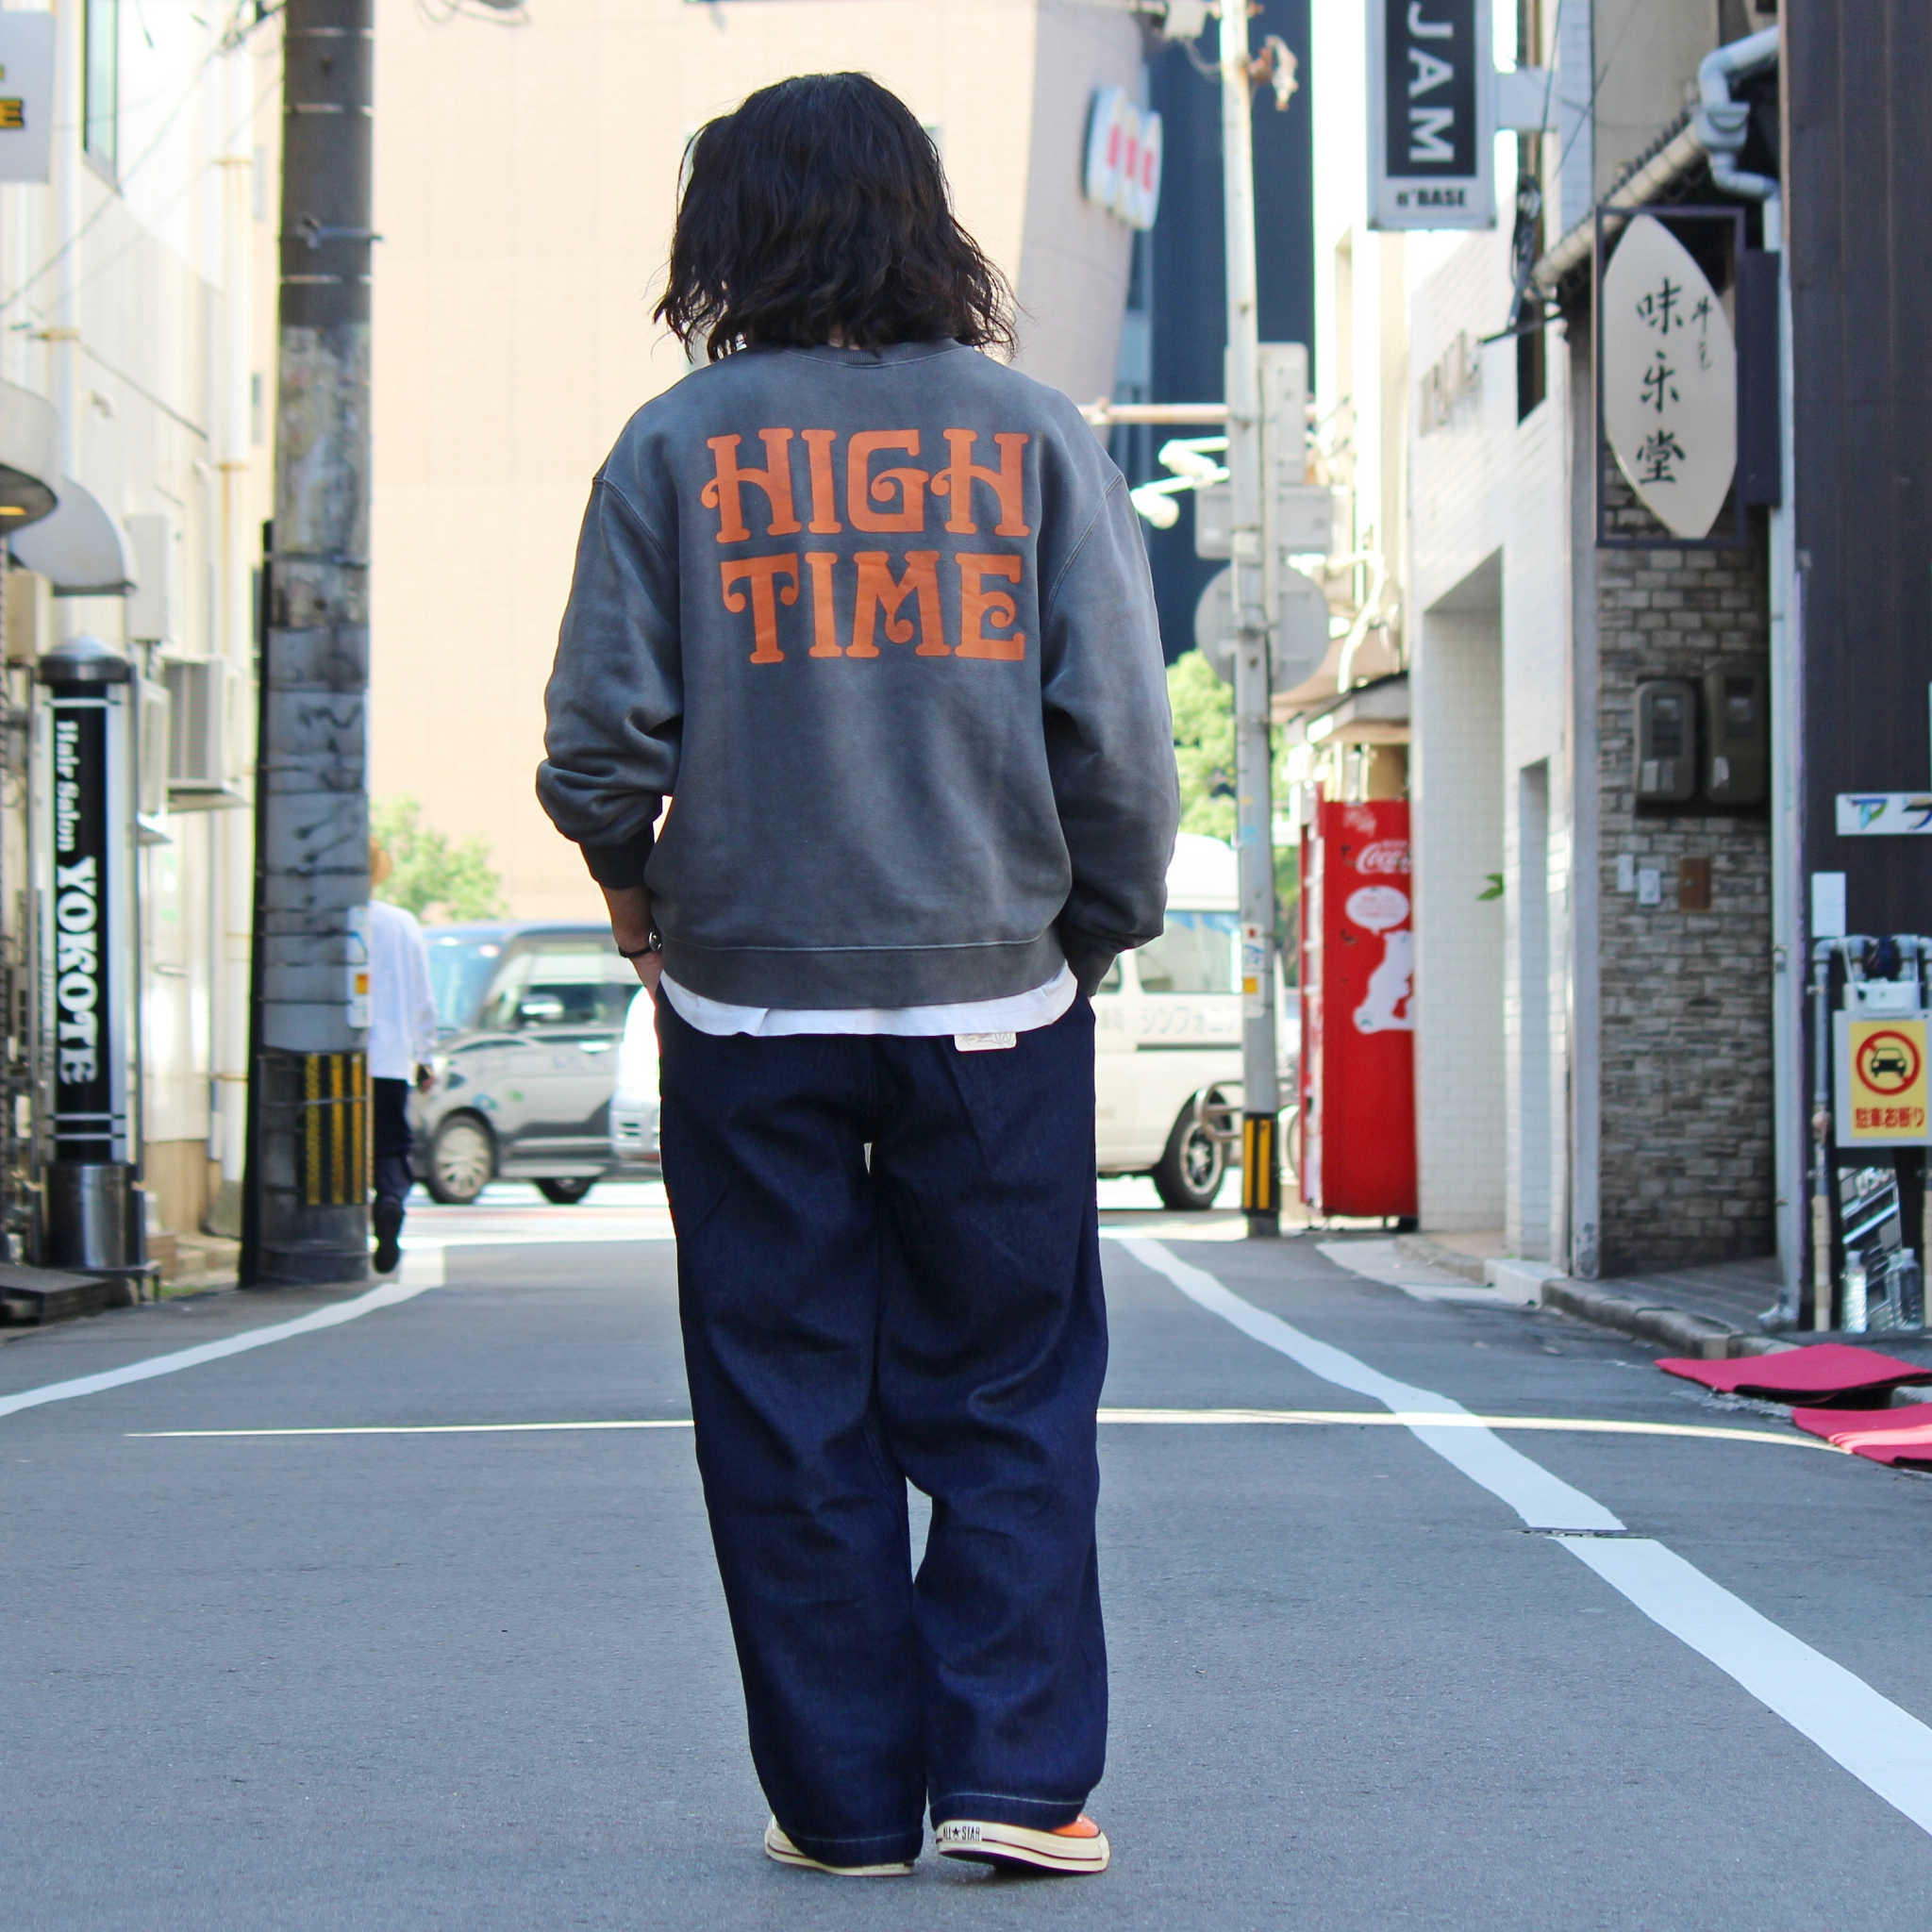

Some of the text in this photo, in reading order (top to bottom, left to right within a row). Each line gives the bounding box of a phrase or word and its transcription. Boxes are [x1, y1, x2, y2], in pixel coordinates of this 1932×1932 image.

[1407, 0, 1455, 162] JAM
[701, 427, 1030, 543] HIGH
[721, 550, 1025, 664] TIME
[57, 722, 99, 1085] Hair Salon YOKOTE
[1856, 1107, 1925, 1129] 駐車お断り
[961, 1826, 981, 1841] STAR
